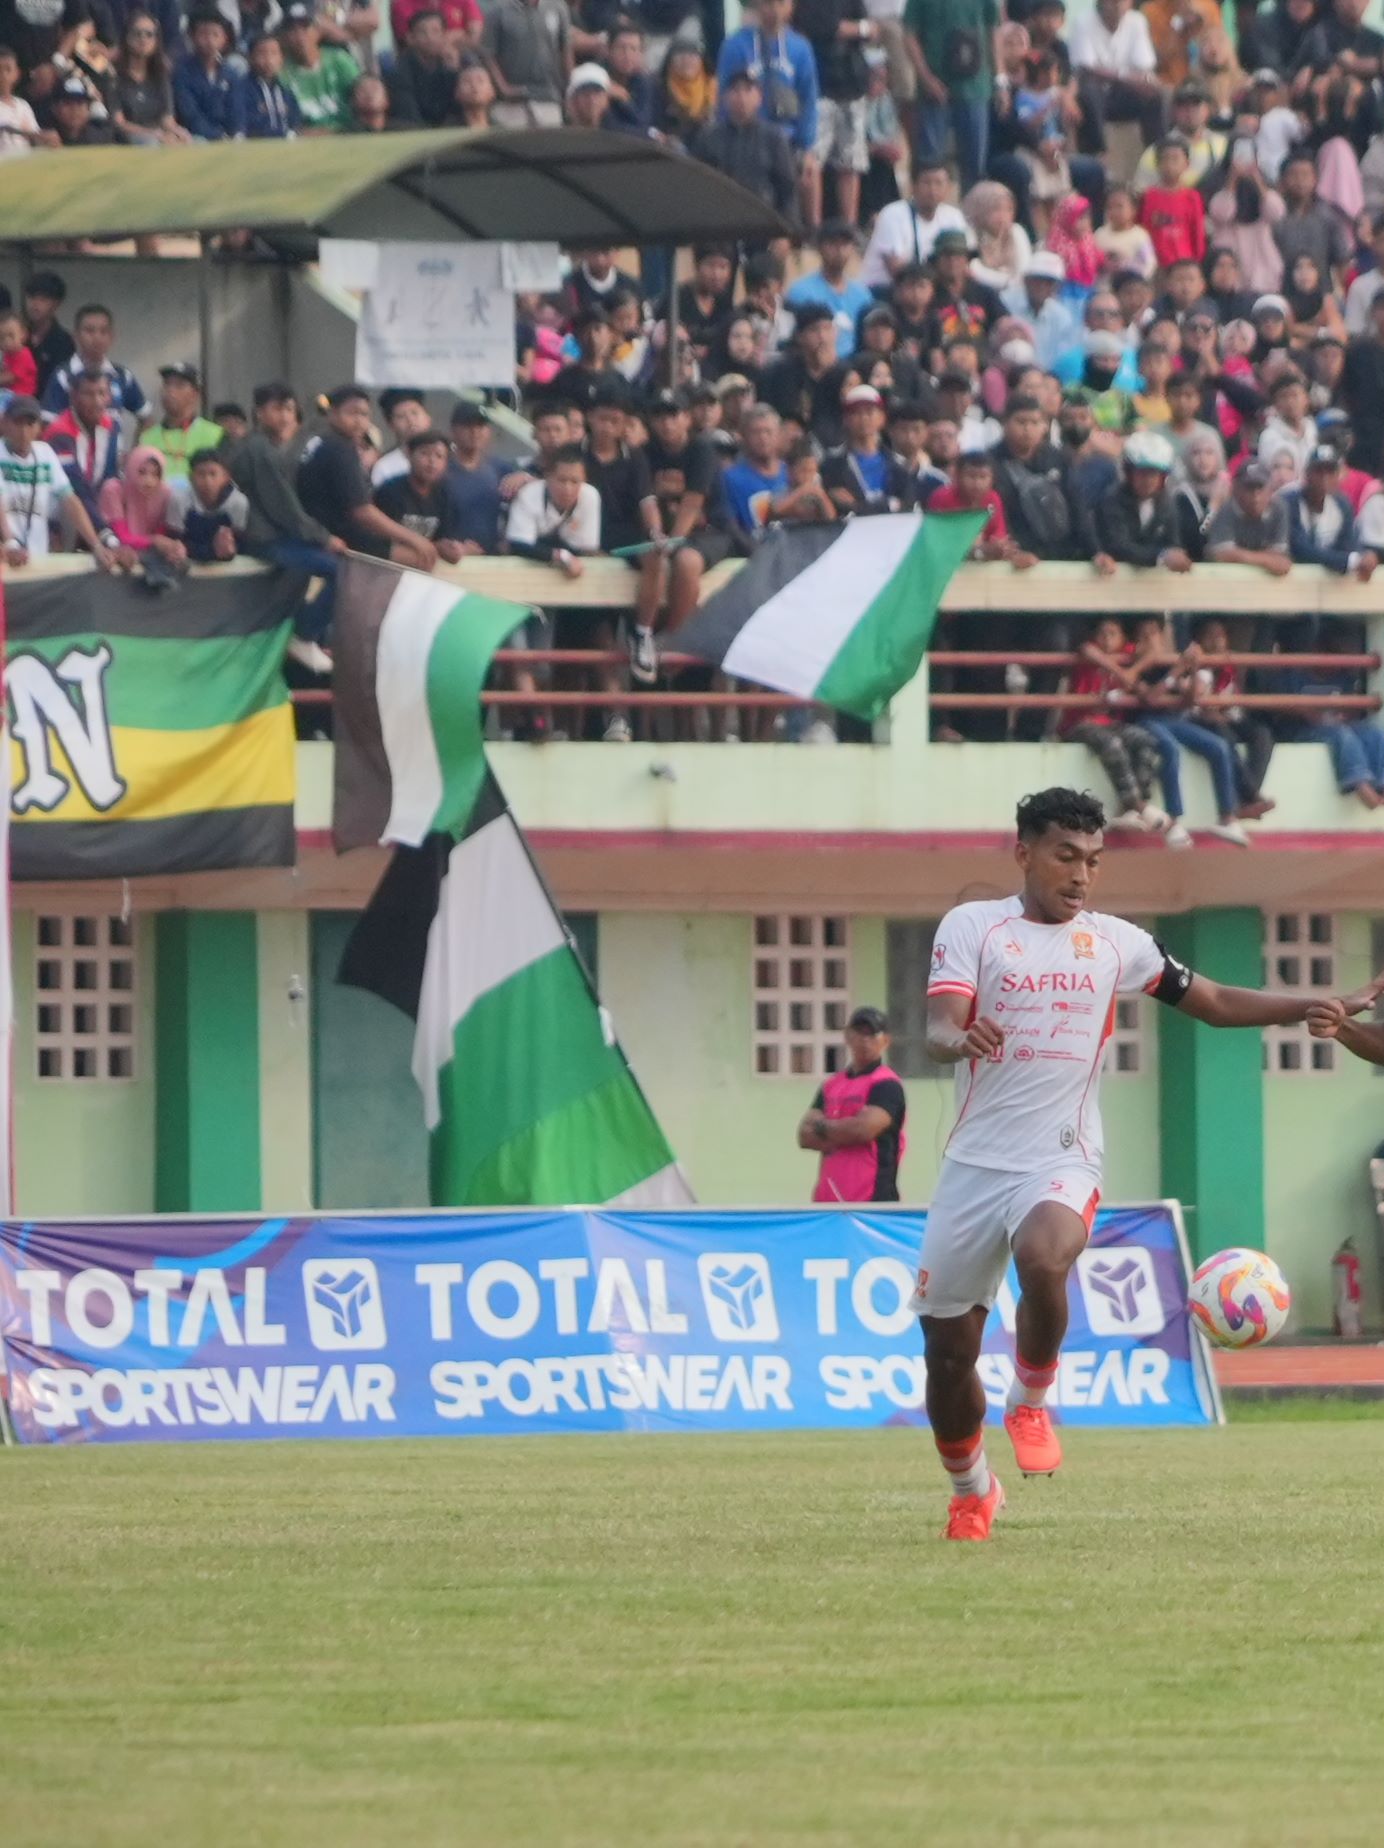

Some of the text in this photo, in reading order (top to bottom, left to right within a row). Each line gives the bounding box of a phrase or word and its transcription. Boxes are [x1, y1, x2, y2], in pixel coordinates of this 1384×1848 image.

[1000, 973, 1095, 993] SAFRIA
[16, 1267, 286, 1346] TOTAL
[415, 1258, 688, 1340] TOTAL
[27, 1363, 397, 1428] SPORTSWEAR
[430, 1353, 794, 1420] SPORTSWEAR
